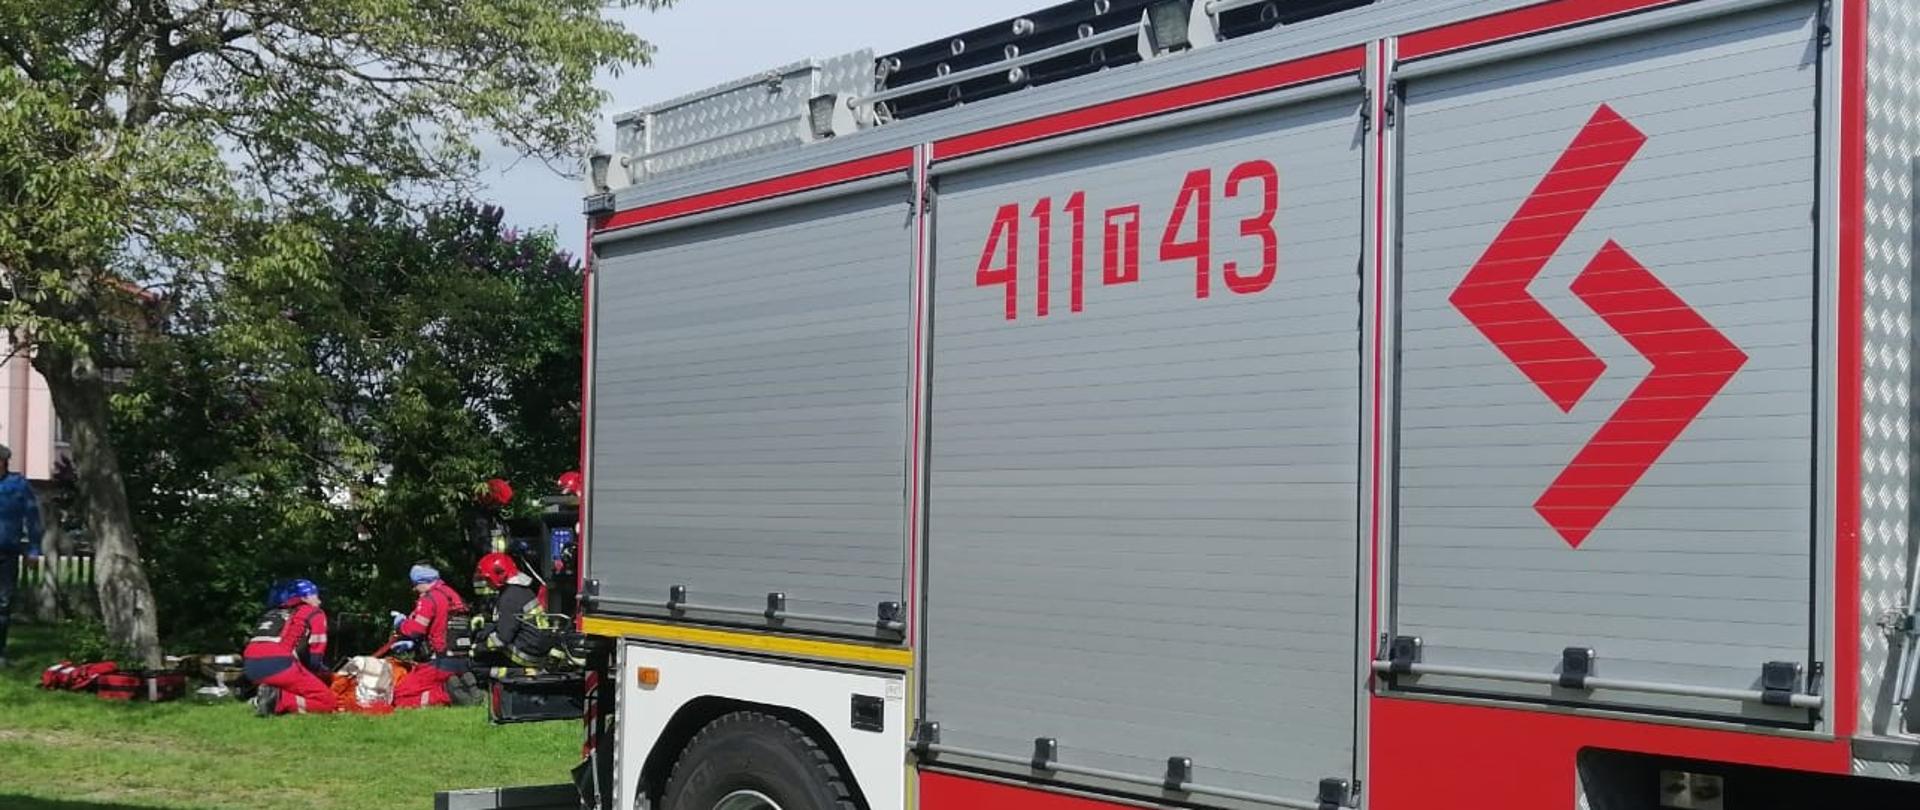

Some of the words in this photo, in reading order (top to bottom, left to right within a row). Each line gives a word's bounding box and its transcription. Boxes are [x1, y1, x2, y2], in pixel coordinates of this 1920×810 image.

[976, 191, 1085, 320] 411
[1107, 209, 1137, 281] T
[1160, 159, 1278, 299] 43
